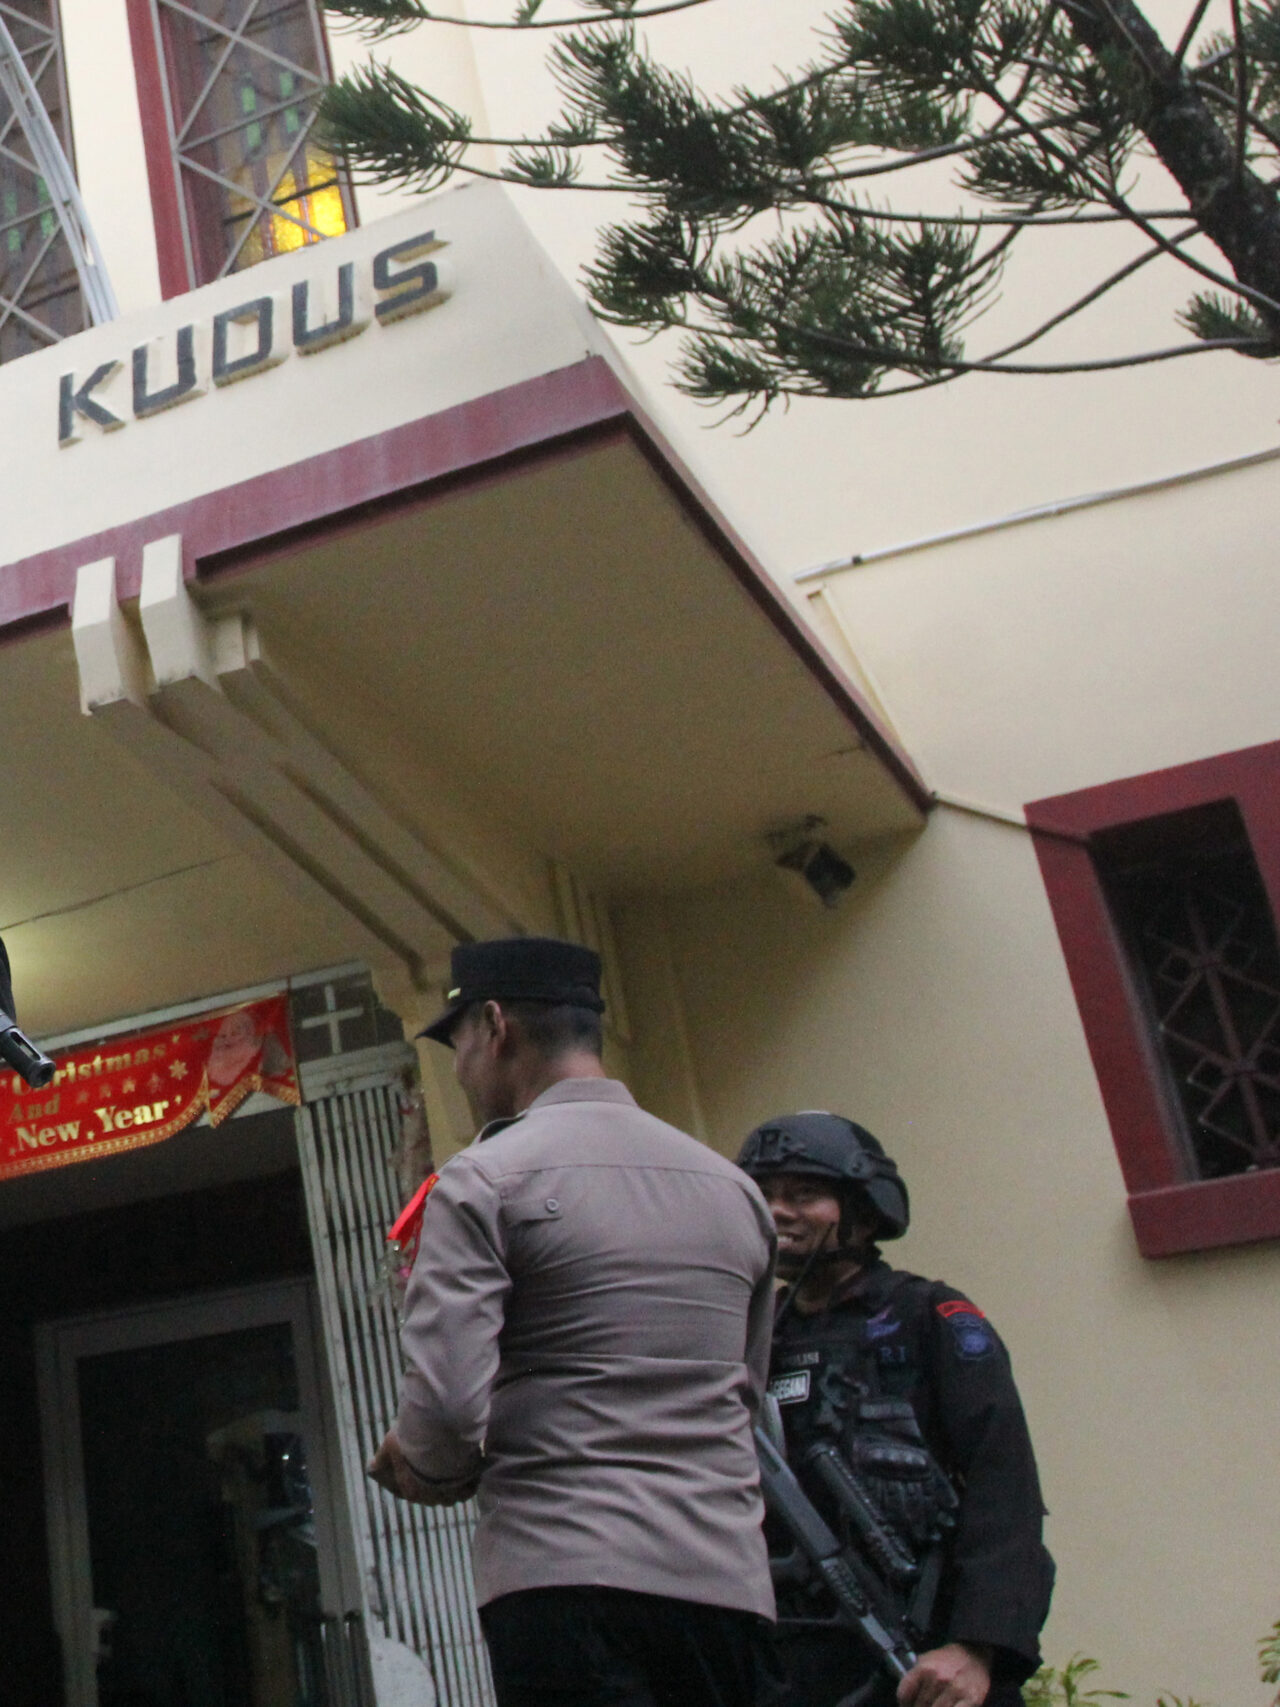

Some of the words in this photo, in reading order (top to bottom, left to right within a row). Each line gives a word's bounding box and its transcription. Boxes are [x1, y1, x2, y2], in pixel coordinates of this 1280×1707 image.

[58, 229, 446, 446] KUDUS
[12, 1044, 166, 1096] Cristmas
[8, 1093, 60, 1124] And
[16, 1120, 81, 1149] New
[94, 1099, 169, 1133] Year
